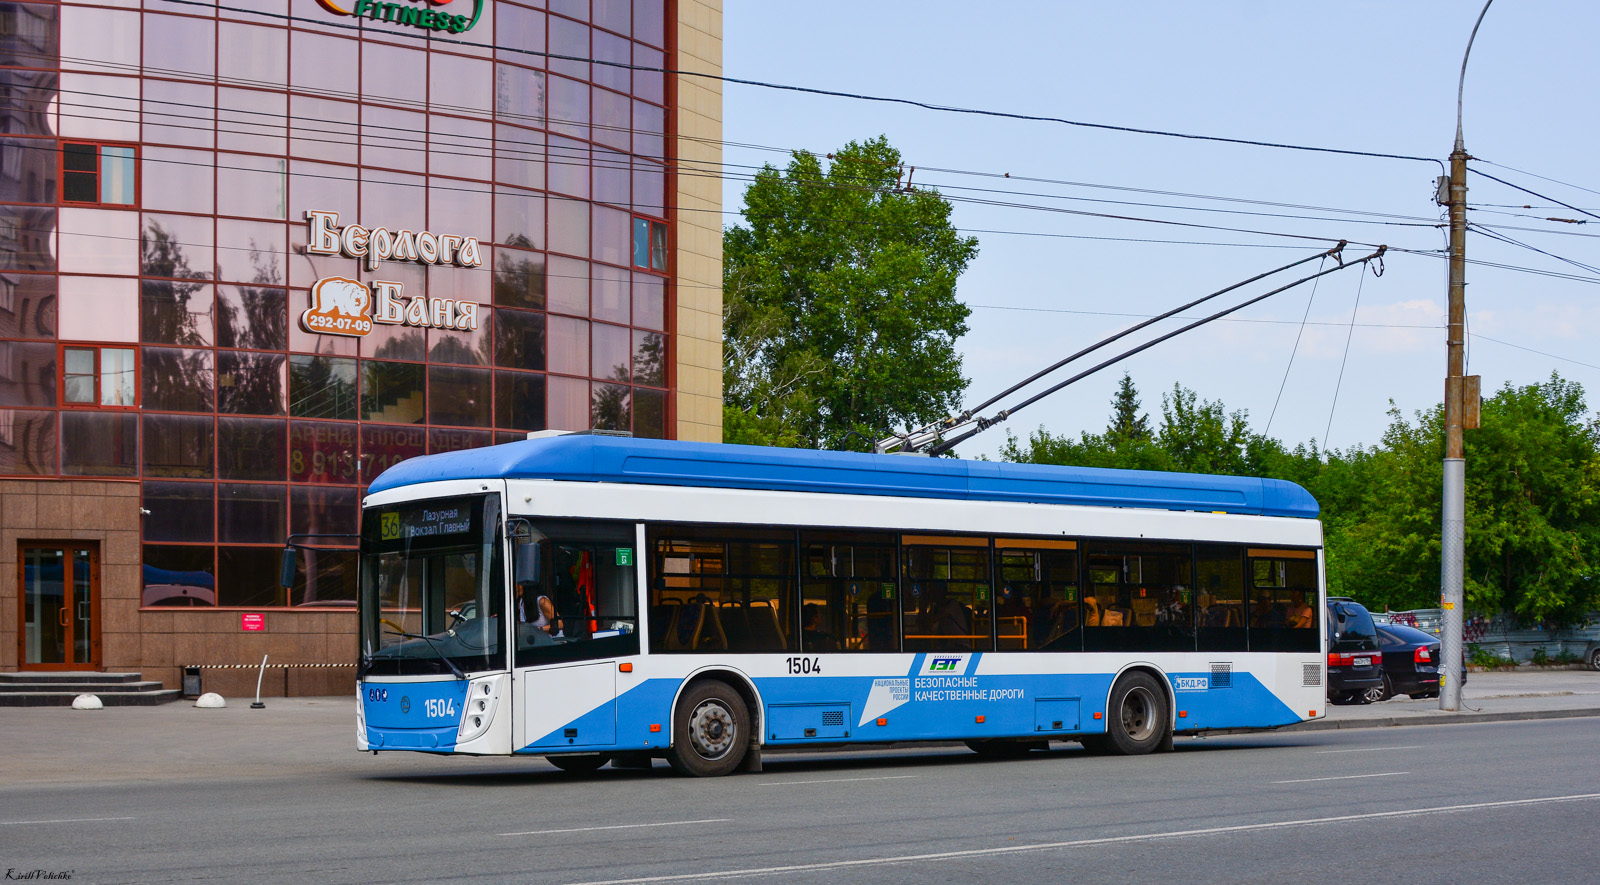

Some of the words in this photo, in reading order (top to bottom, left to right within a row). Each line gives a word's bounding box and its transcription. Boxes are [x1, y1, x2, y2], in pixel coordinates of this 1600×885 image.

[355, 0, 468, 33] FITNESS
[306, 209, 483, 271] Берлога
[372, 280, 480, 331] Баня
[309, 314, 371, 332] 292-07-09
[291, 449, 304, 475] 8
[422, 508, 458, 522] Лазурная
[381, 516, 399, 538] 36
[410, 523, 437, 536] Вокзал
[439, 520, 470, 533] Главный
[786, 657, 821, 675] 1504
[915, 677, 978, 688] БЕЗОПАСНЫЕ
[1181, 679, 1207, 688] БКД.РФ
[915, 689, 988, 701] КАЧЕСТВЕННЫЕ
[989, 689, 1025, 701] ДОРОГИ
[424, 698, 455, 717] 1504
